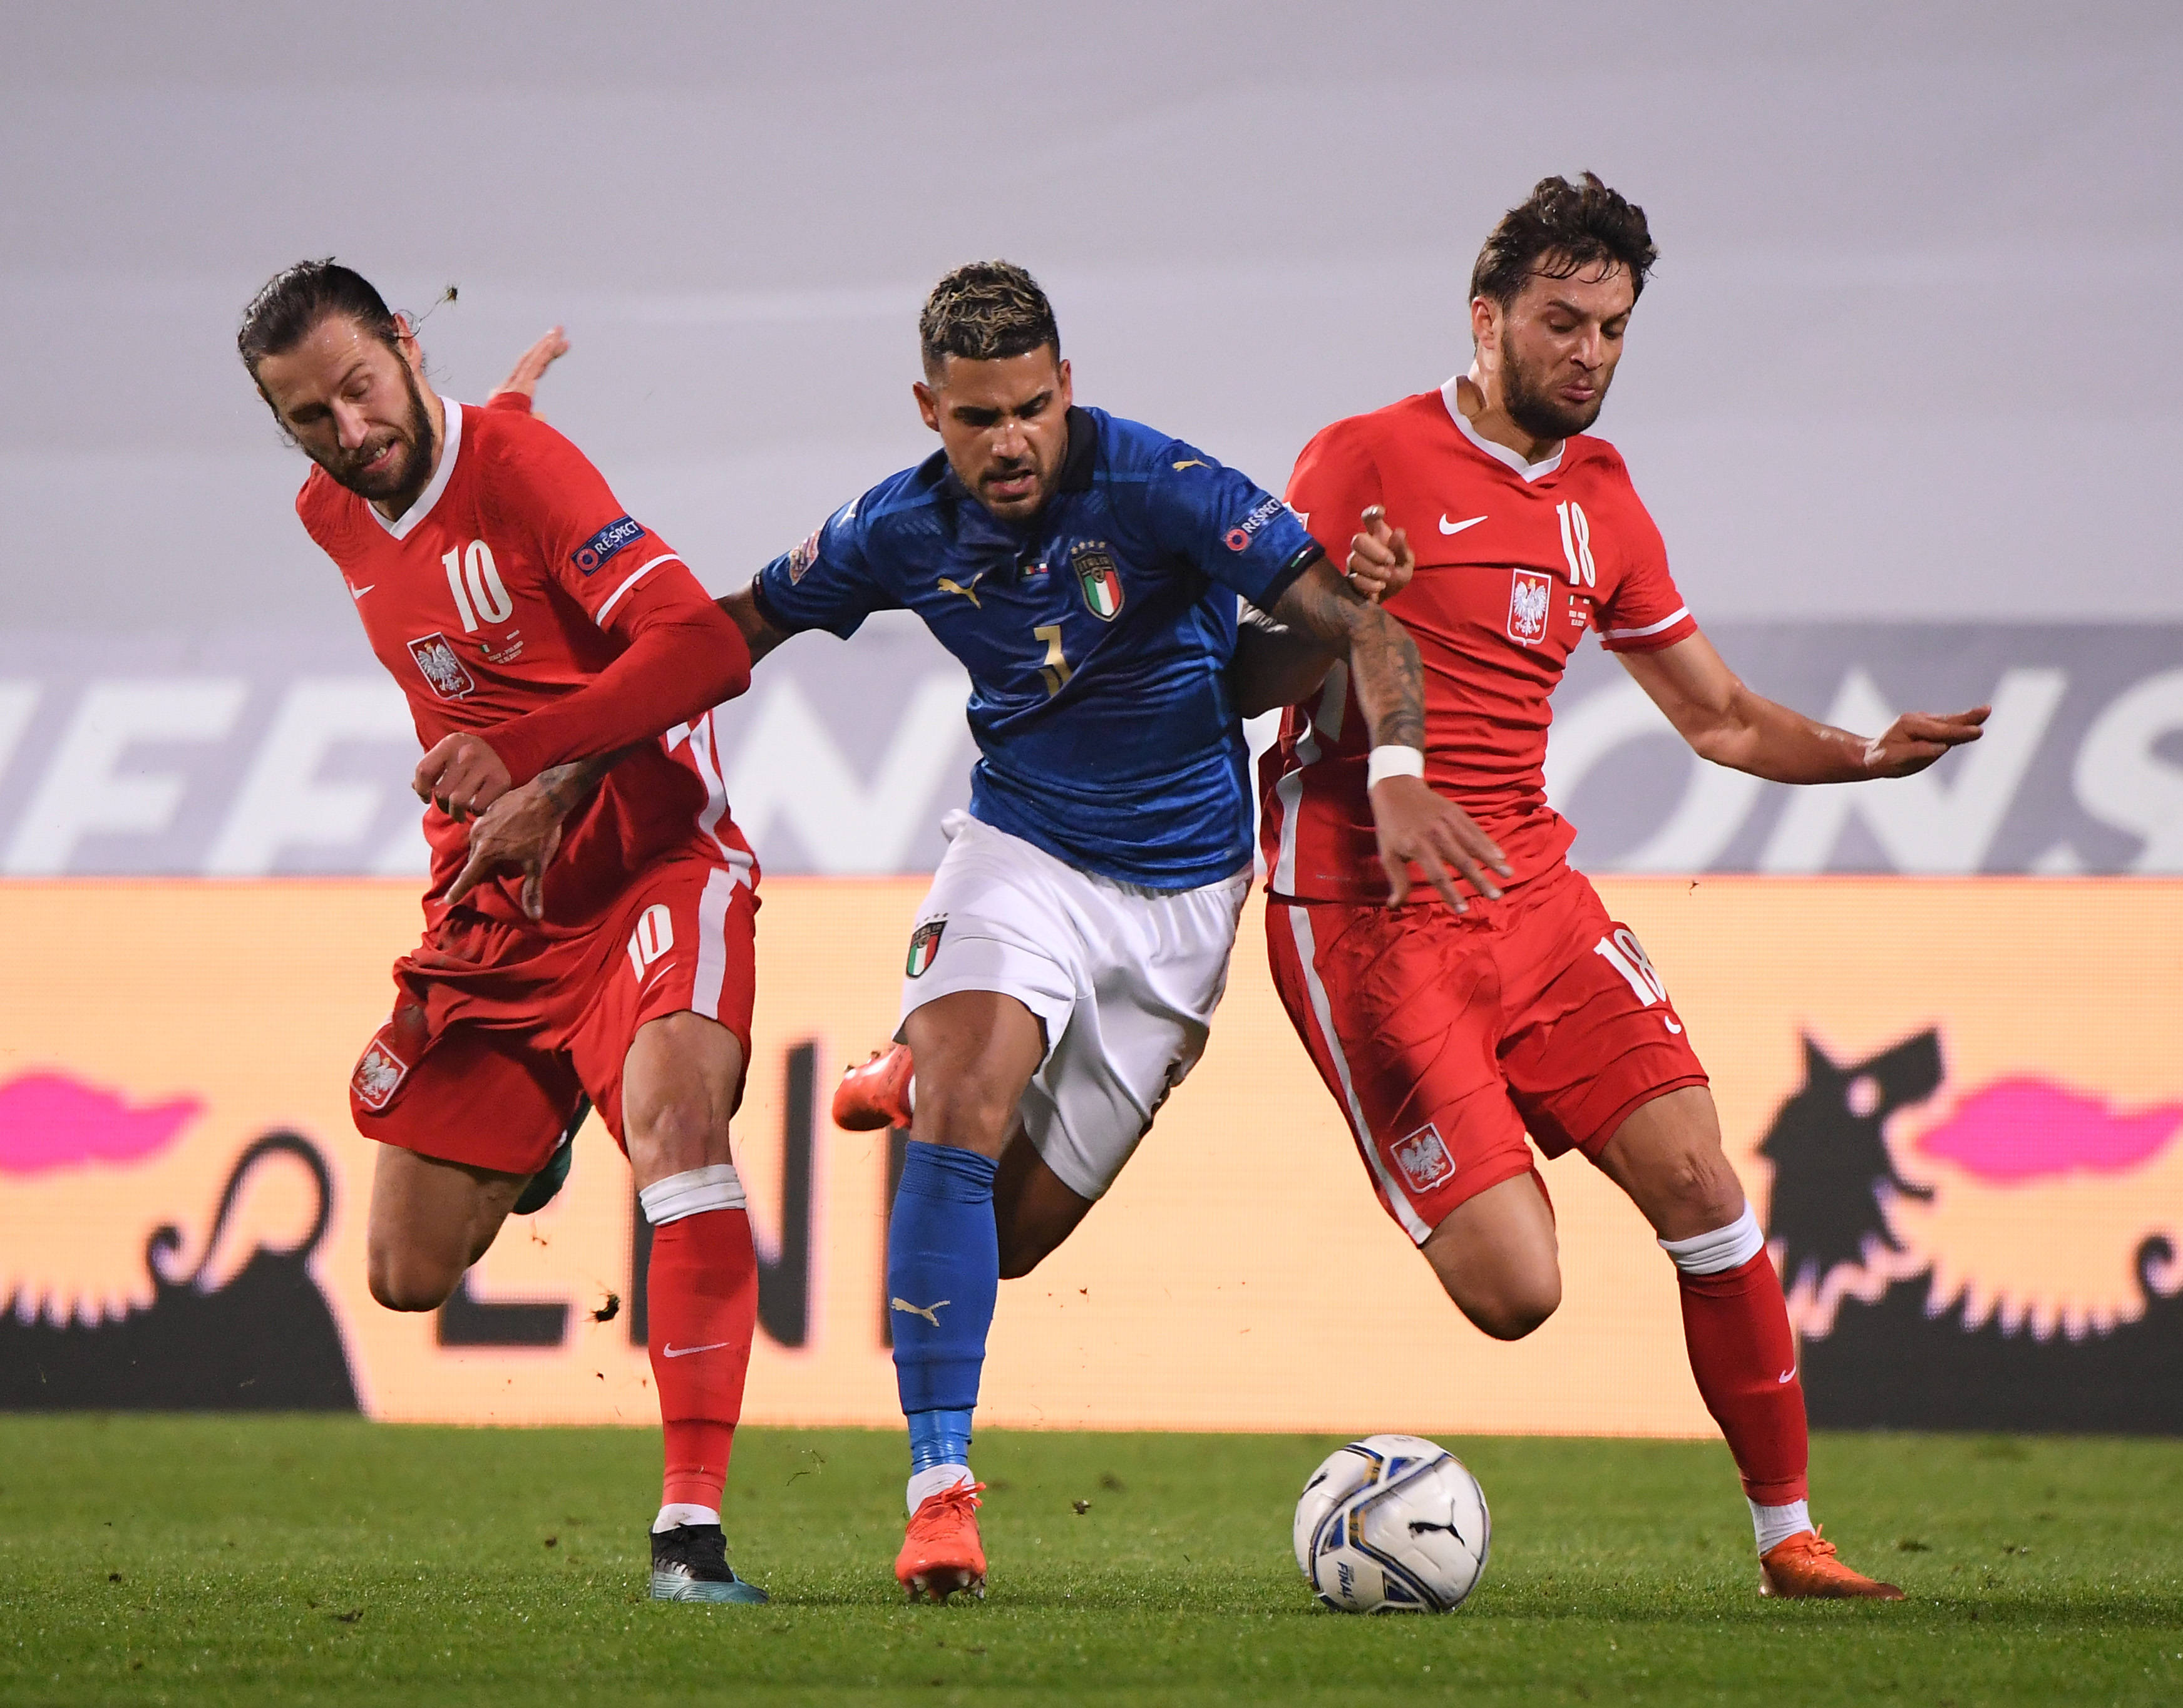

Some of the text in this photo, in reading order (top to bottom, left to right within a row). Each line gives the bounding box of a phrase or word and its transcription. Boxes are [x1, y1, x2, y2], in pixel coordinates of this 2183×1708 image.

[595, 521, 639, 555] RESPECT
[1241, 498, 1280, 533] RESPECT
[1556, 500, 1596, 588] 18
[442, 540, 513, 633] 10
[1034, 625, 1072, 699] 7
[627, 904, 674, 984] 10
[1593, 929, 1667, 1007] 18
